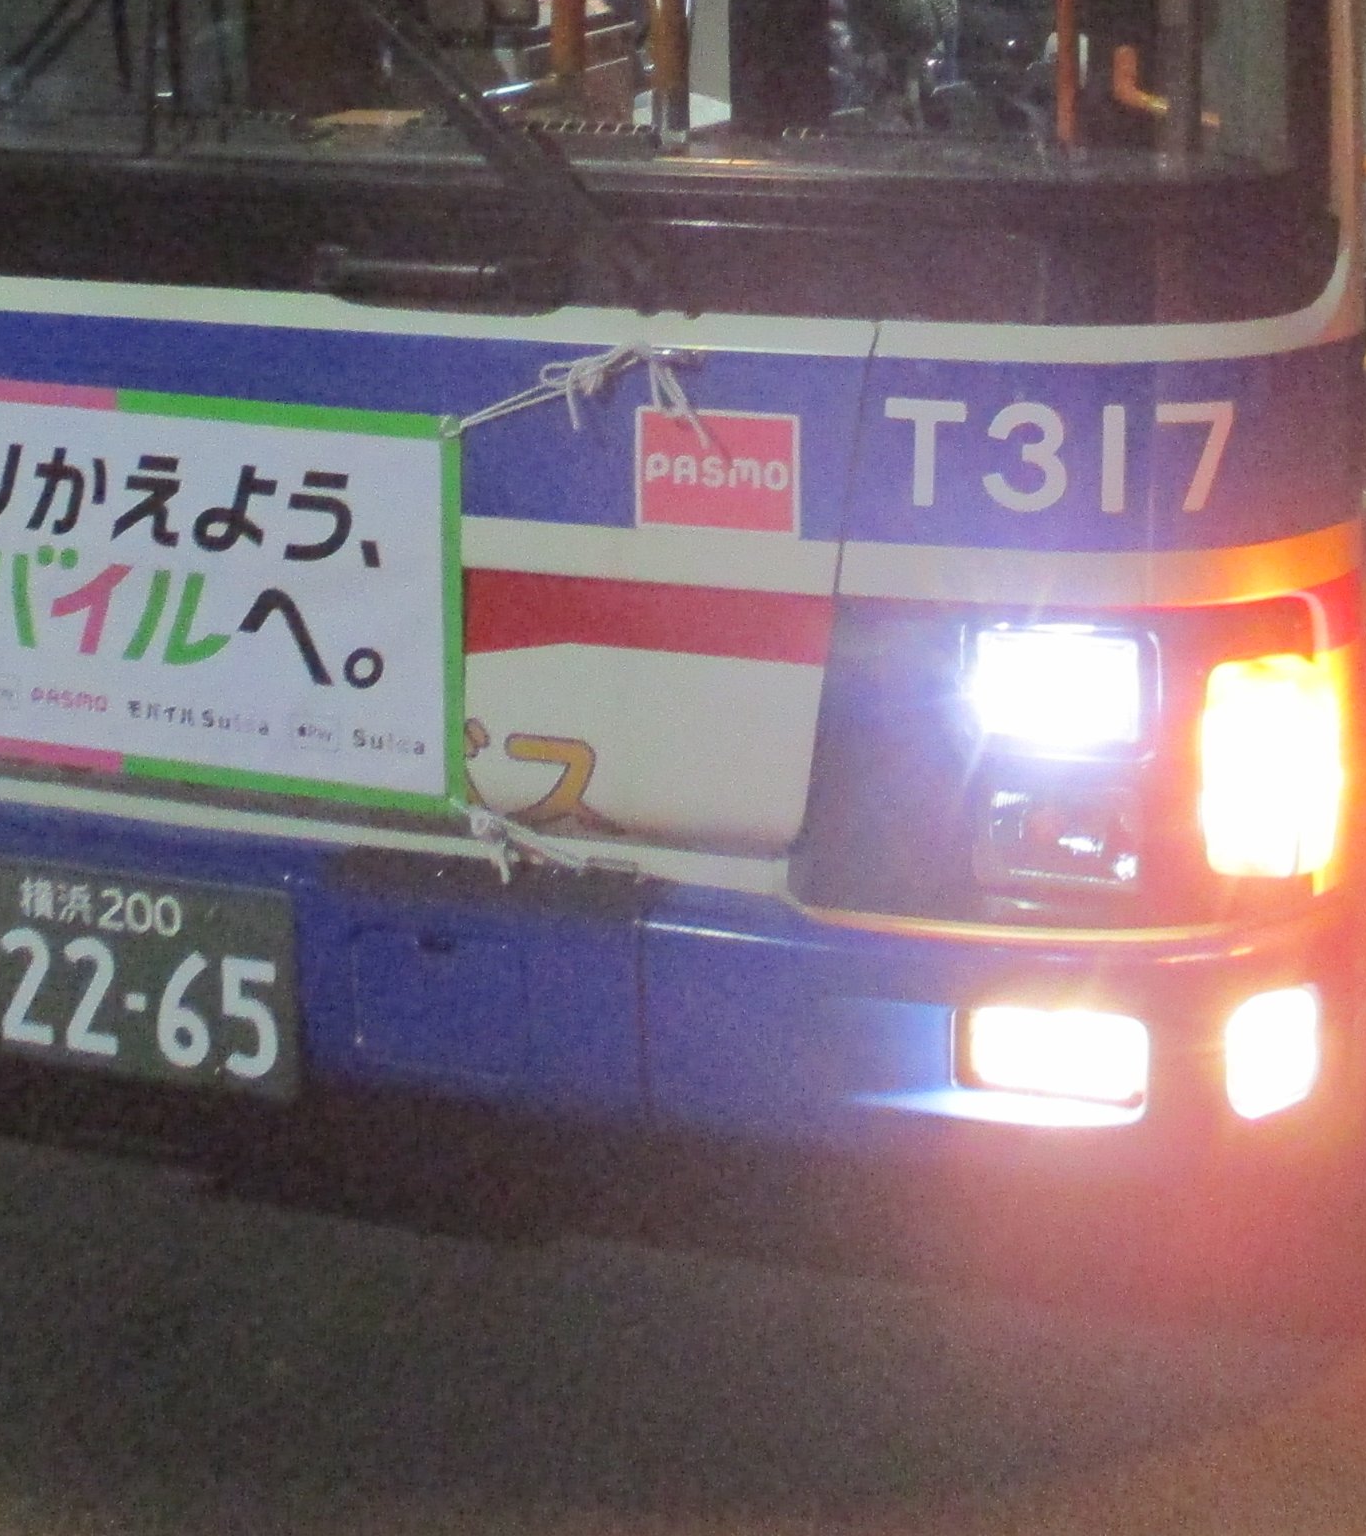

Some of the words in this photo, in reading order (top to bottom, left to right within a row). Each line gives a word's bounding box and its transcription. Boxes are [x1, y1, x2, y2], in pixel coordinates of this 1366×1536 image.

[644, 452, 789, 492] PASMO
[884, 397, 1236, 513] T317
[30, 686, 108, 713] PASMO
[0, 927, 278, 1080] 22-65
